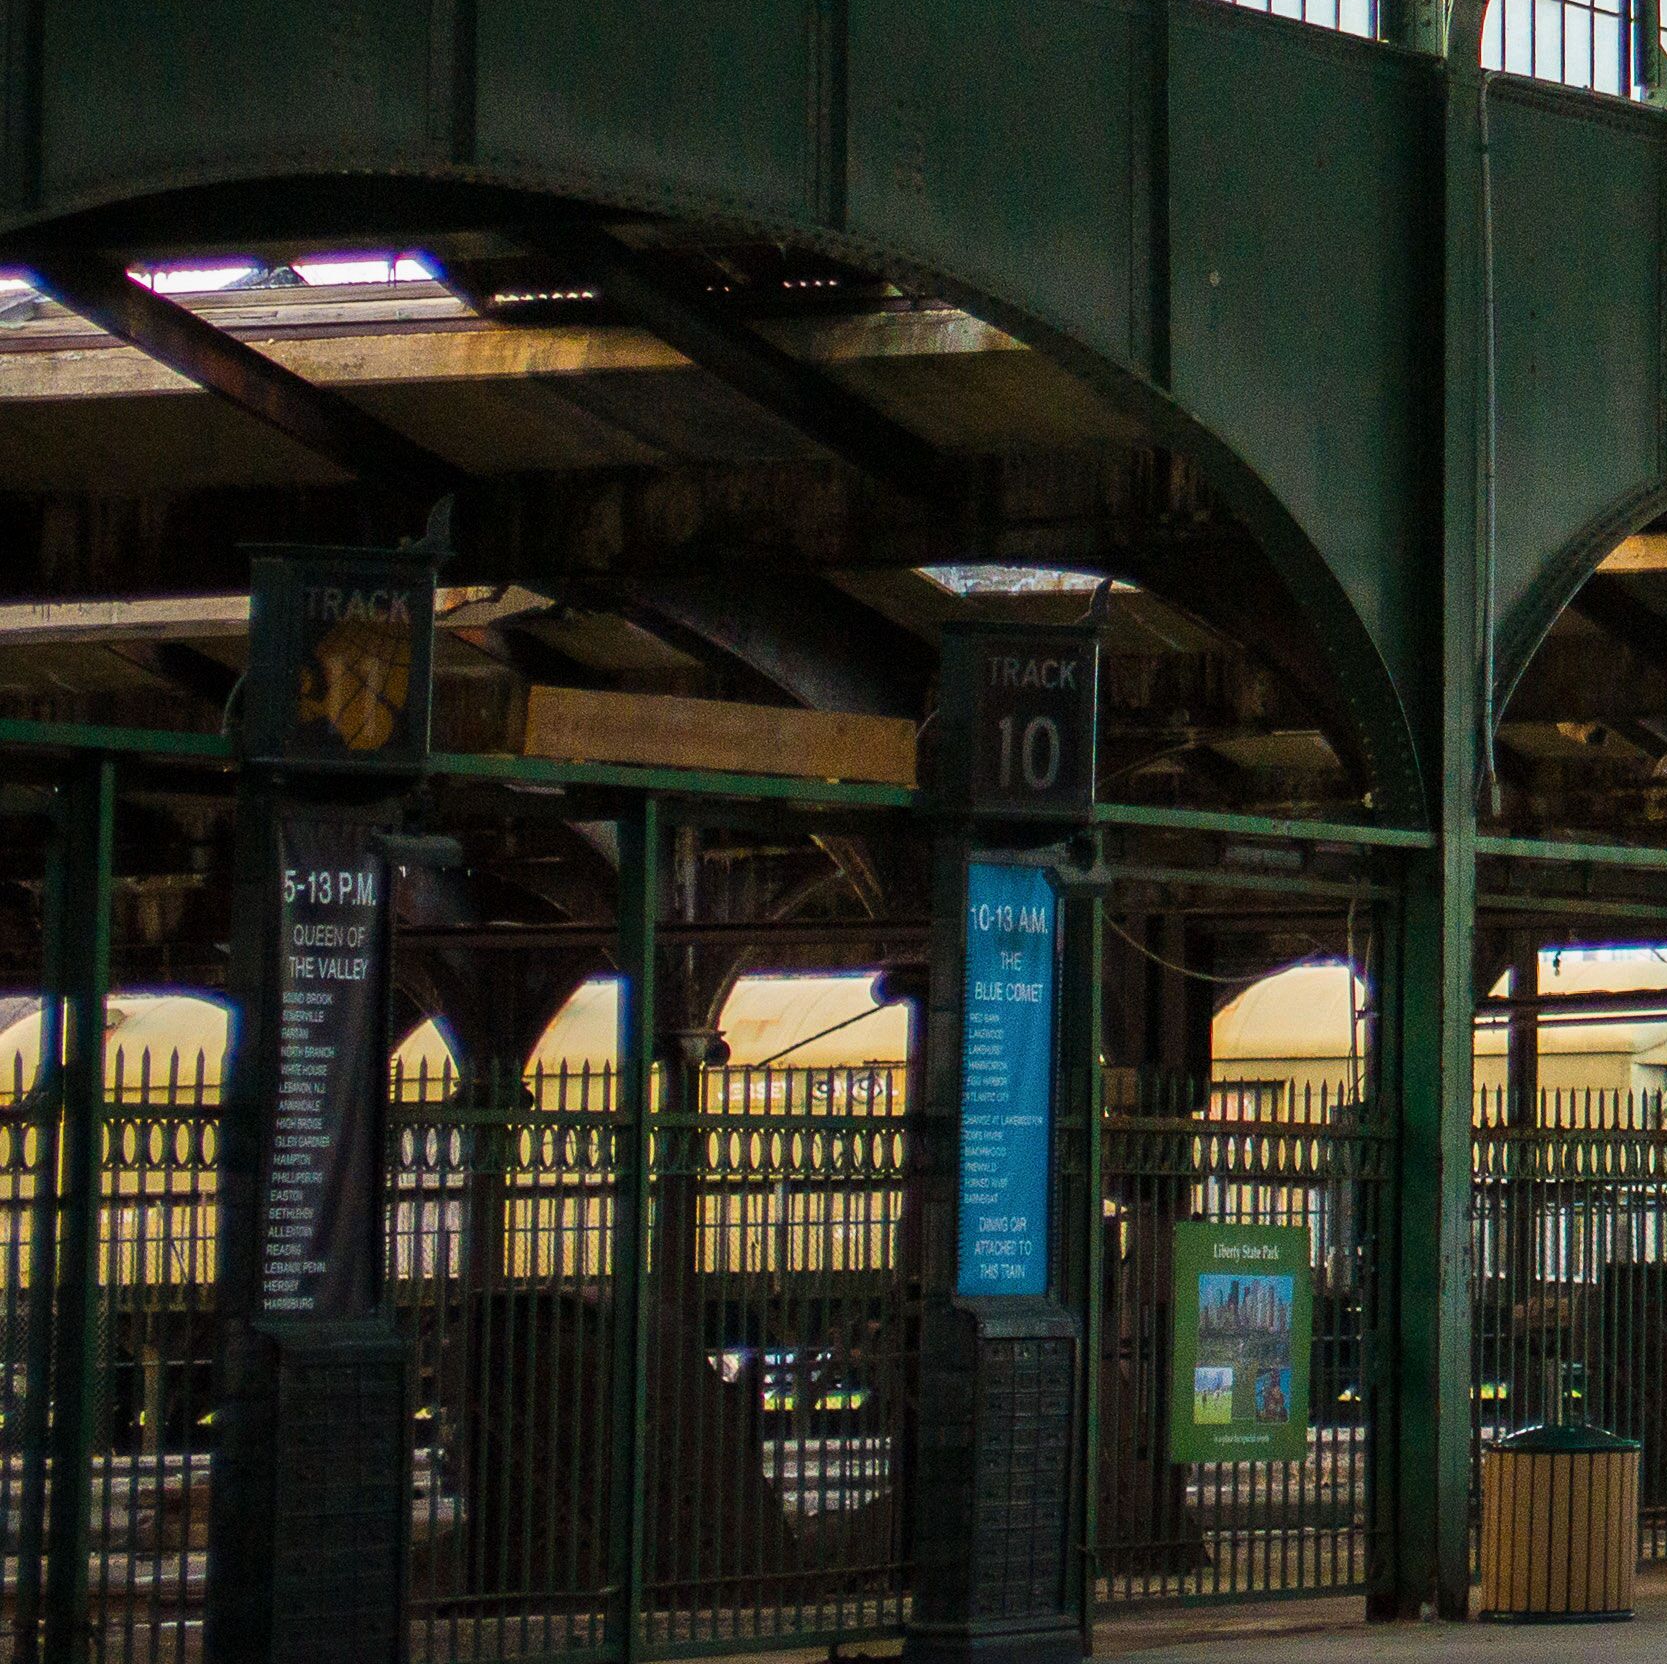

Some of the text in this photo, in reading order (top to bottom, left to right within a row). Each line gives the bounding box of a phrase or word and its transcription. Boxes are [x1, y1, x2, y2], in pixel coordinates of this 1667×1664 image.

[303, 587, 412, 623] TRACK
[988, 656, 1077, 688] TRACK
[1000, 716, 1060, 789] 10
[284, 870, 377, 906] 5-13 P.M.
[970, 903, 1048, 934] 10-13 A.M.
[293, 924, 367, 948] QUEEN OF
[289, 956, 369, 980] THE VALLEY
[1000, 951, 1023, 971] THE
[974, 981, 1044, 1003] BLUE COMET
[979, 1216, 1028, 1233] DINING CAR
[974, 1239, 1033, 1256] ATTACHED TO
[1213, 1243, 1279, 1264] Liberty State Park
[979, 1263, 1026, 1279] THIS TRAIN
